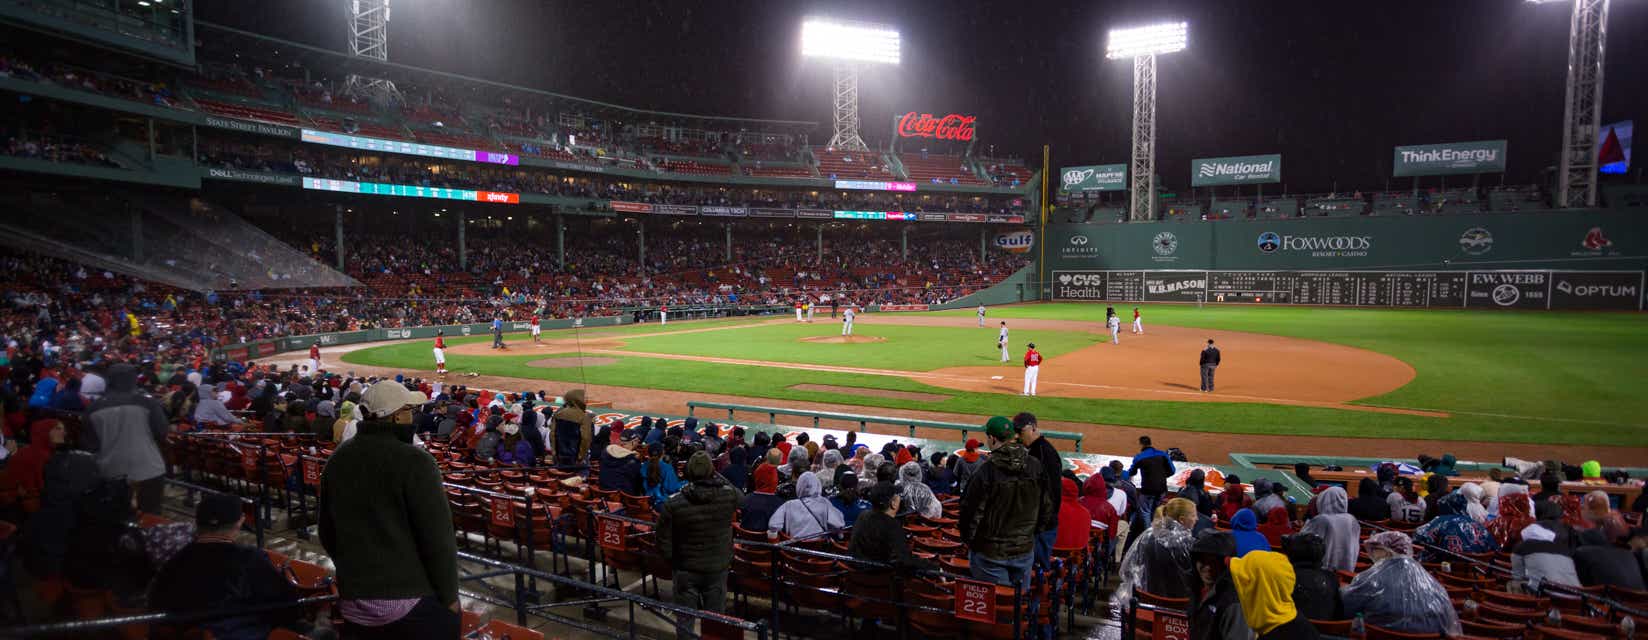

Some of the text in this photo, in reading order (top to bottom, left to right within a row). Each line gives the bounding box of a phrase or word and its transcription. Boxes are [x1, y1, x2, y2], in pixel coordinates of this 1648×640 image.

[207, 118, 291, 136] STATE STREET PAVILION
[1401, 149, 1496, 163] ThinkEnergy
[210, 169, 232, 178] DELL
[1216, 161, 1272, 175] National
[996, 234, 1032, 246] Gulf
[1283, 235, 1371, 250] FOXWOODS
[1073, 274, 1101, 286] CVS
[1501, 275, 1544, 284] WEBB
[1060, 286, 1101, 298] Health
[1575, 286, 1635, 296] OPTUM
[496, 510, 509, 521] 24
[1402, 508, 1420, 521] 15
[604, 532, 620, 545] 23
[963, 583, 988, 593] FIELD
[966, 590, 985, 600] BOX
[963, 599, 988, 615] 22
[1165, 624, 1188, 635] BOX
